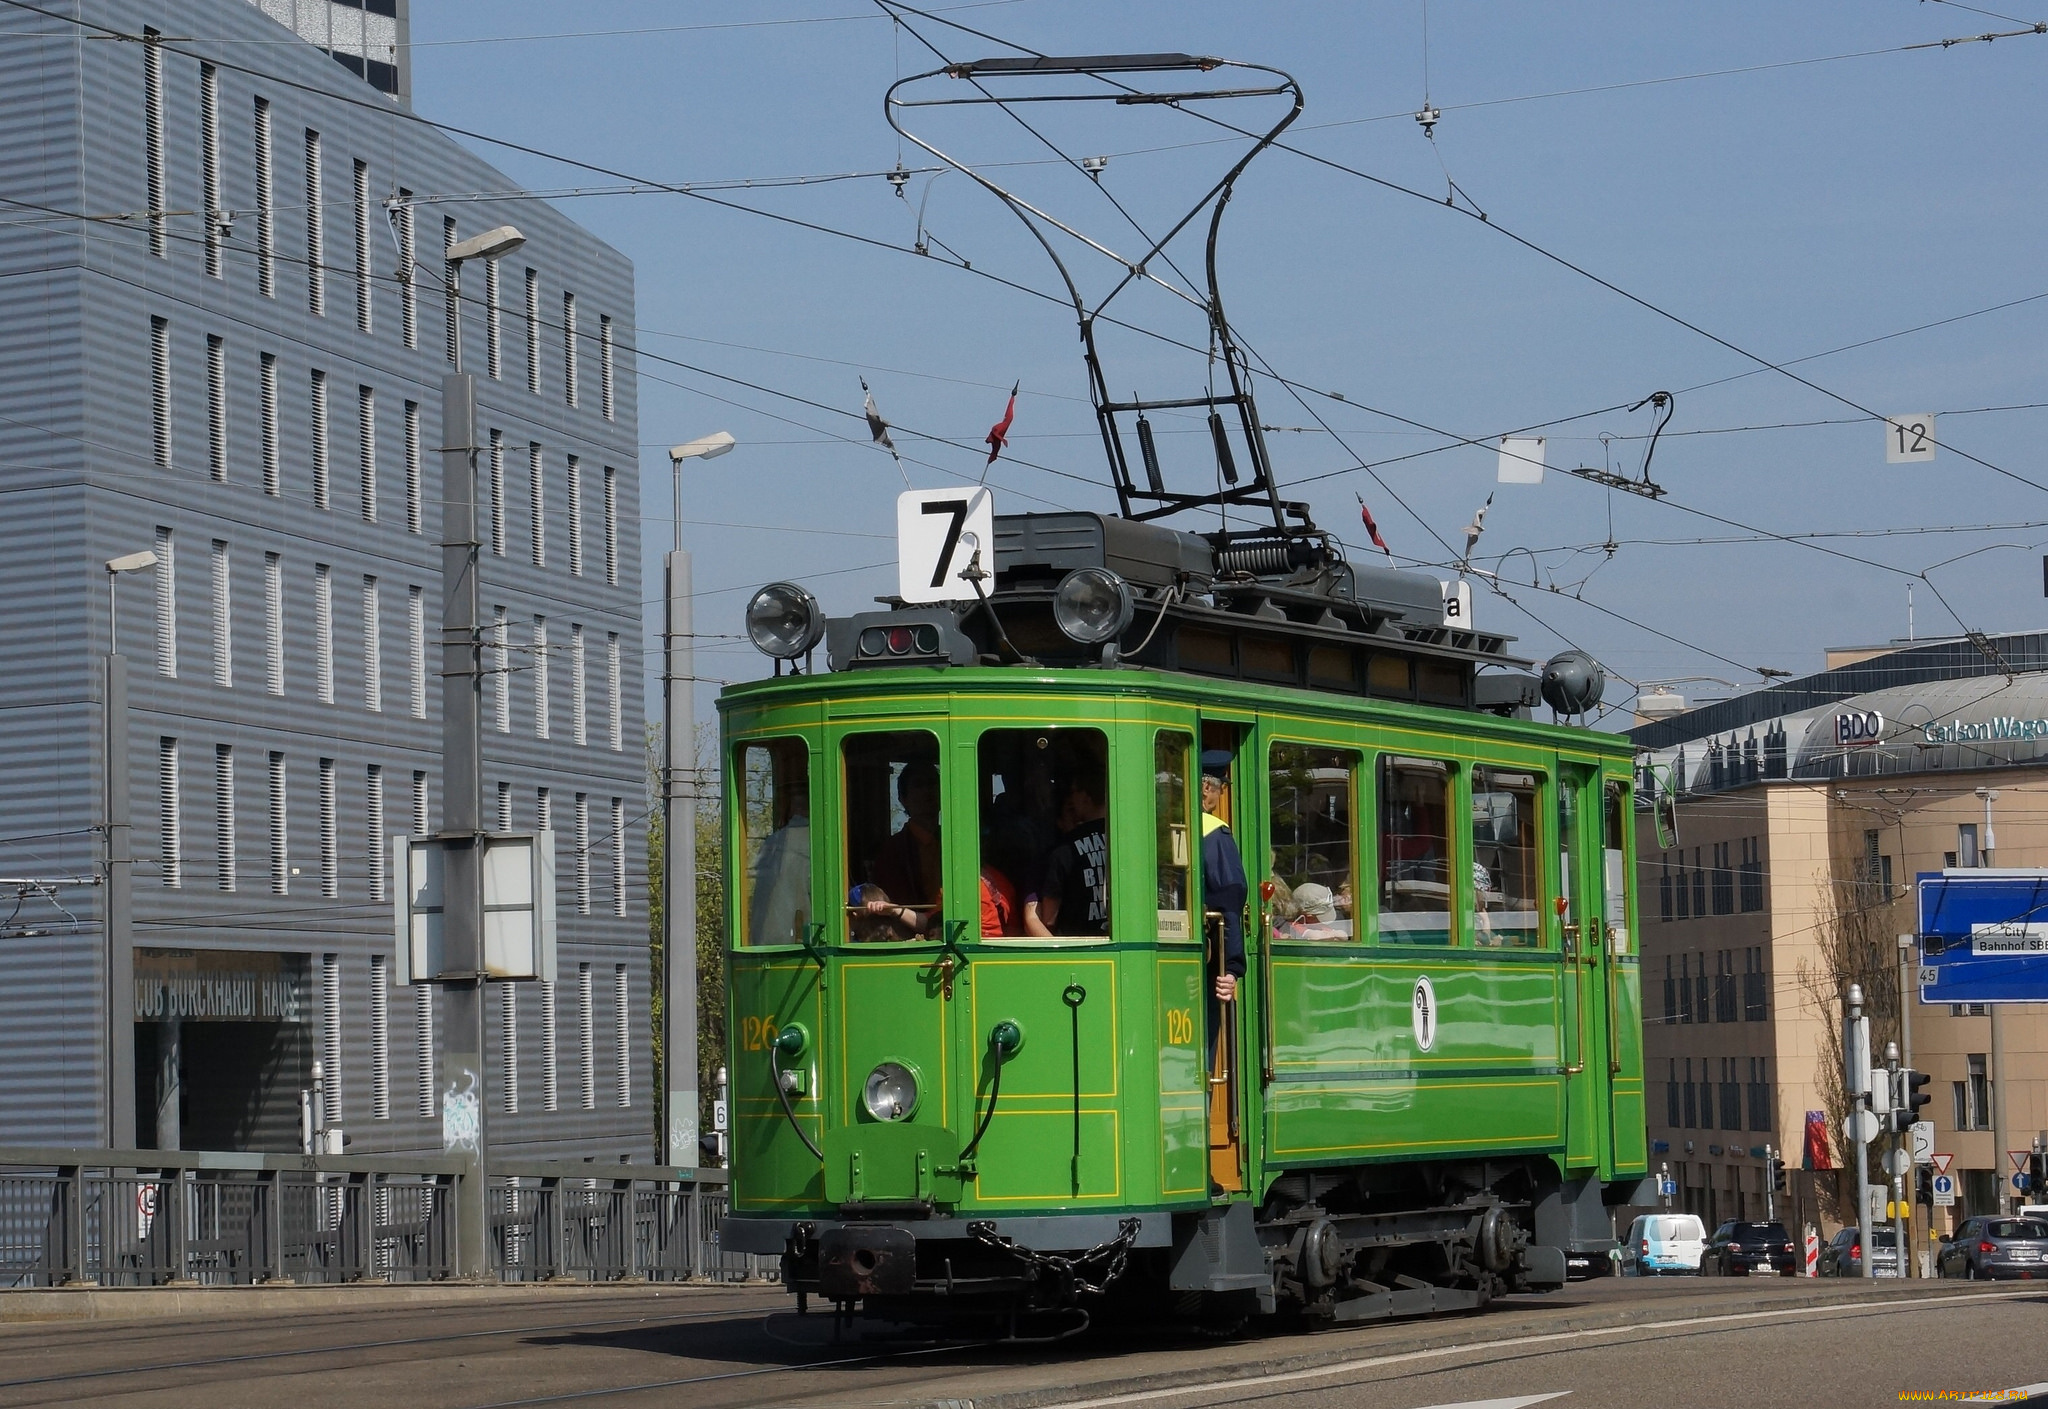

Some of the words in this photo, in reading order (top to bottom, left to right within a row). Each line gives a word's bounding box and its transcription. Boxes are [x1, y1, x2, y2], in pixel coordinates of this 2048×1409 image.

[1896, 423, 1927, 454] 12
[920, 499, 968, 588] 7
[1443, 597, 1460, 617] a
[1839, 710, 1882, 740] BDO
[1924, 720, 1992, 743] Carlson
[1992, 716, 2048, 743] Wago
[1175, 829, 1183, 859] 7
[1979, 940, 2026, 952] Bahnhof
[2004, 926, 2027, 939] City
[1919, 969, 1936, 982] 45
[742, 1014, 778, 1052] 126
[1166, 1007, 1192, 1045] 126
[716, 1106, 726, 1124] 6
